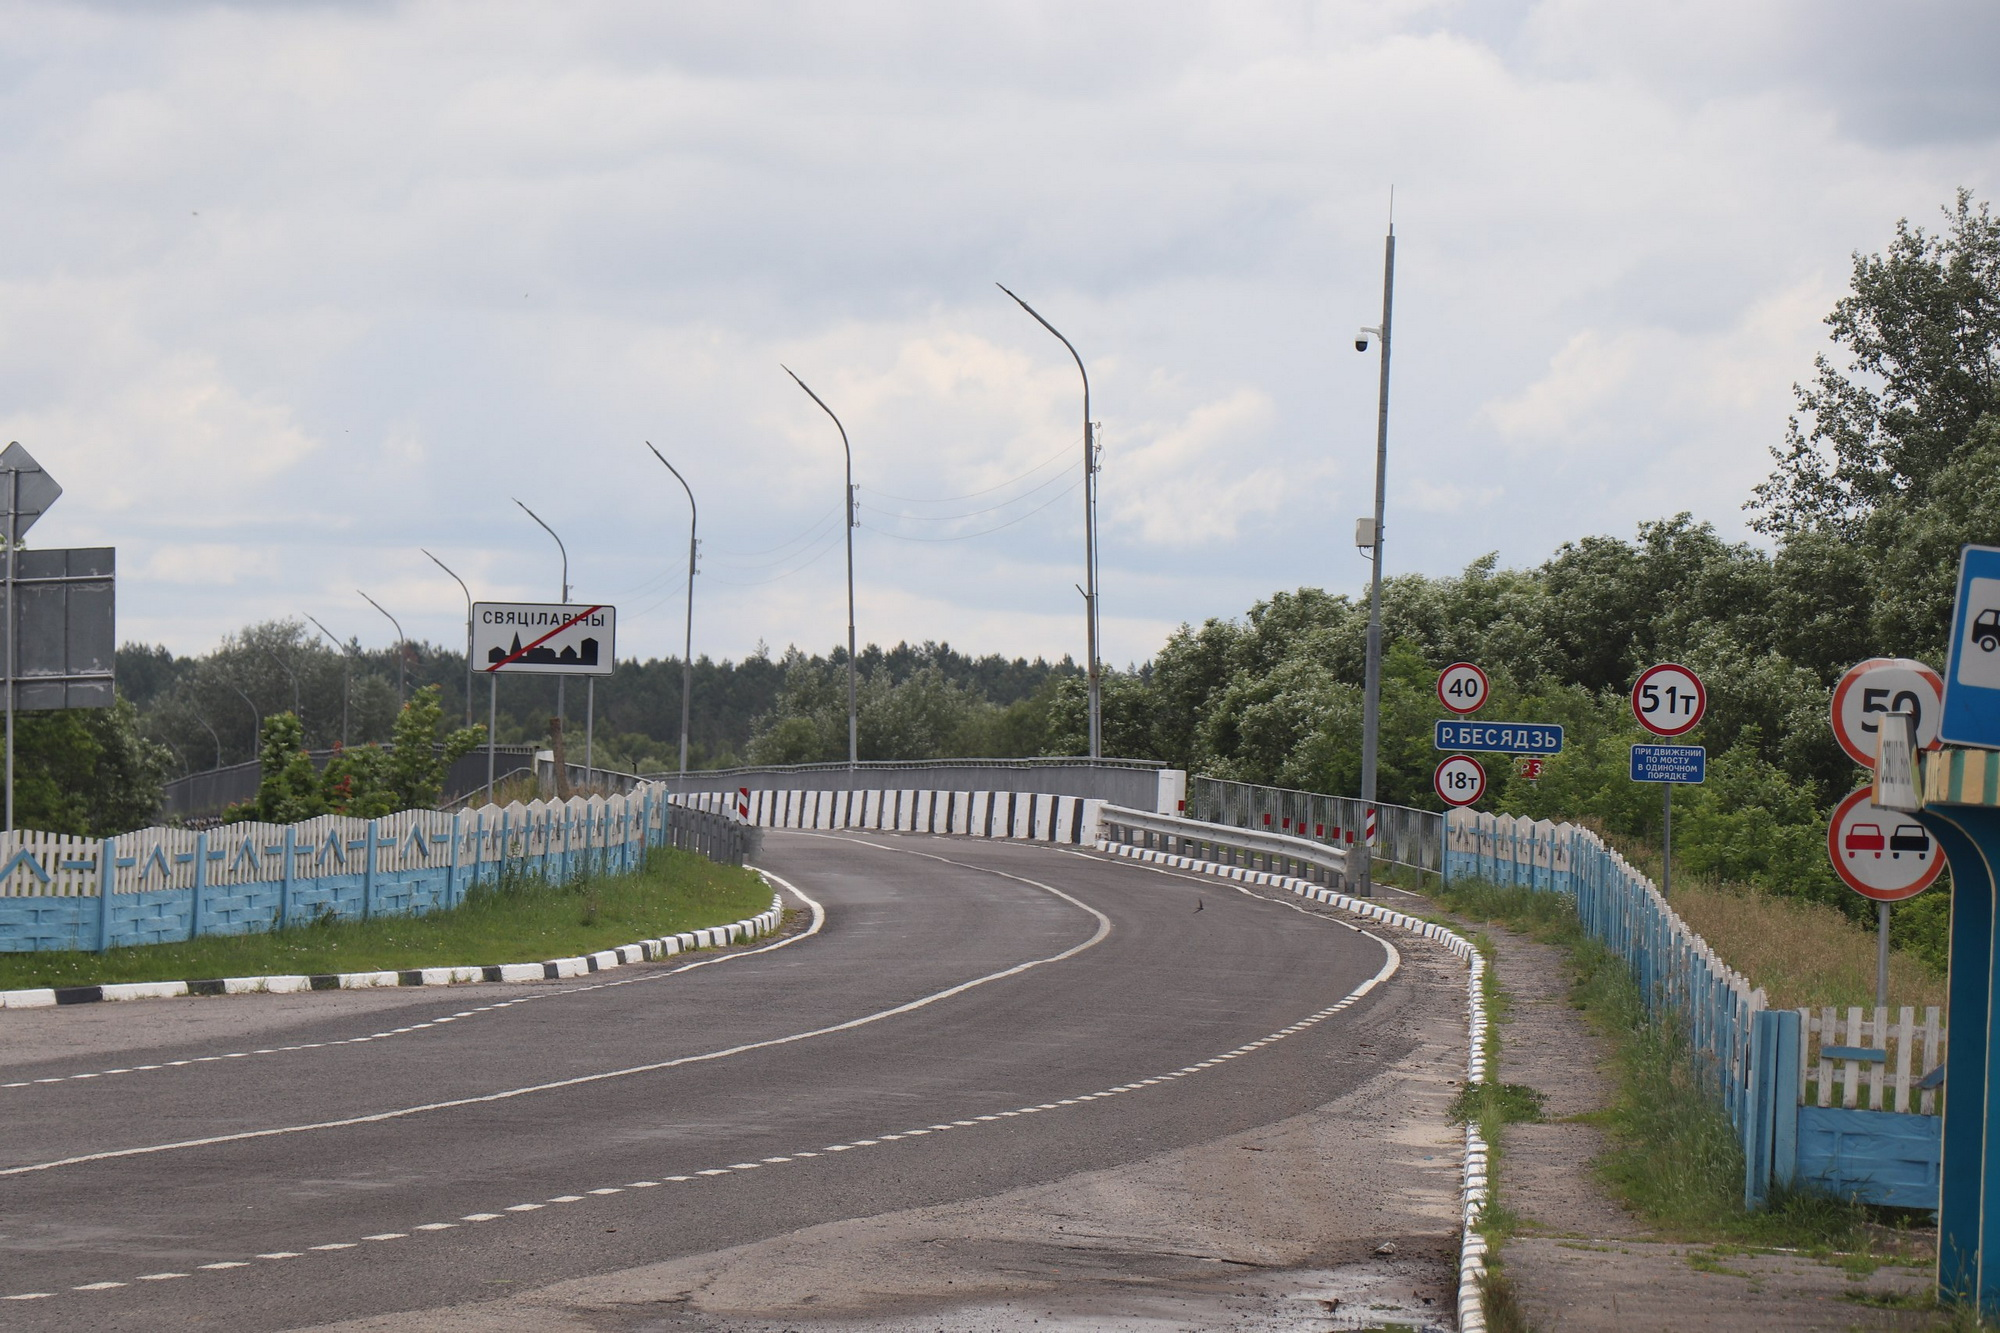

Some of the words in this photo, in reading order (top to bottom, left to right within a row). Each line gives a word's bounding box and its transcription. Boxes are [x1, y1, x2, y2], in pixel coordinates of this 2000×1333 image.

[1448, 678, 1478, 698] 40
[1861, 688, 1921, 733] 50
[1653, 748, 1702, 757] ДВИЖЕНИИ
[1646, 756, 1658, 764] ПО
[1660, 757, 1690, 765] МОСТУ
[1645, 764, 1698, 773] ОДИНОЧНОМ
[1647, 772, 1687, 780] ПОРЯДКЕ
